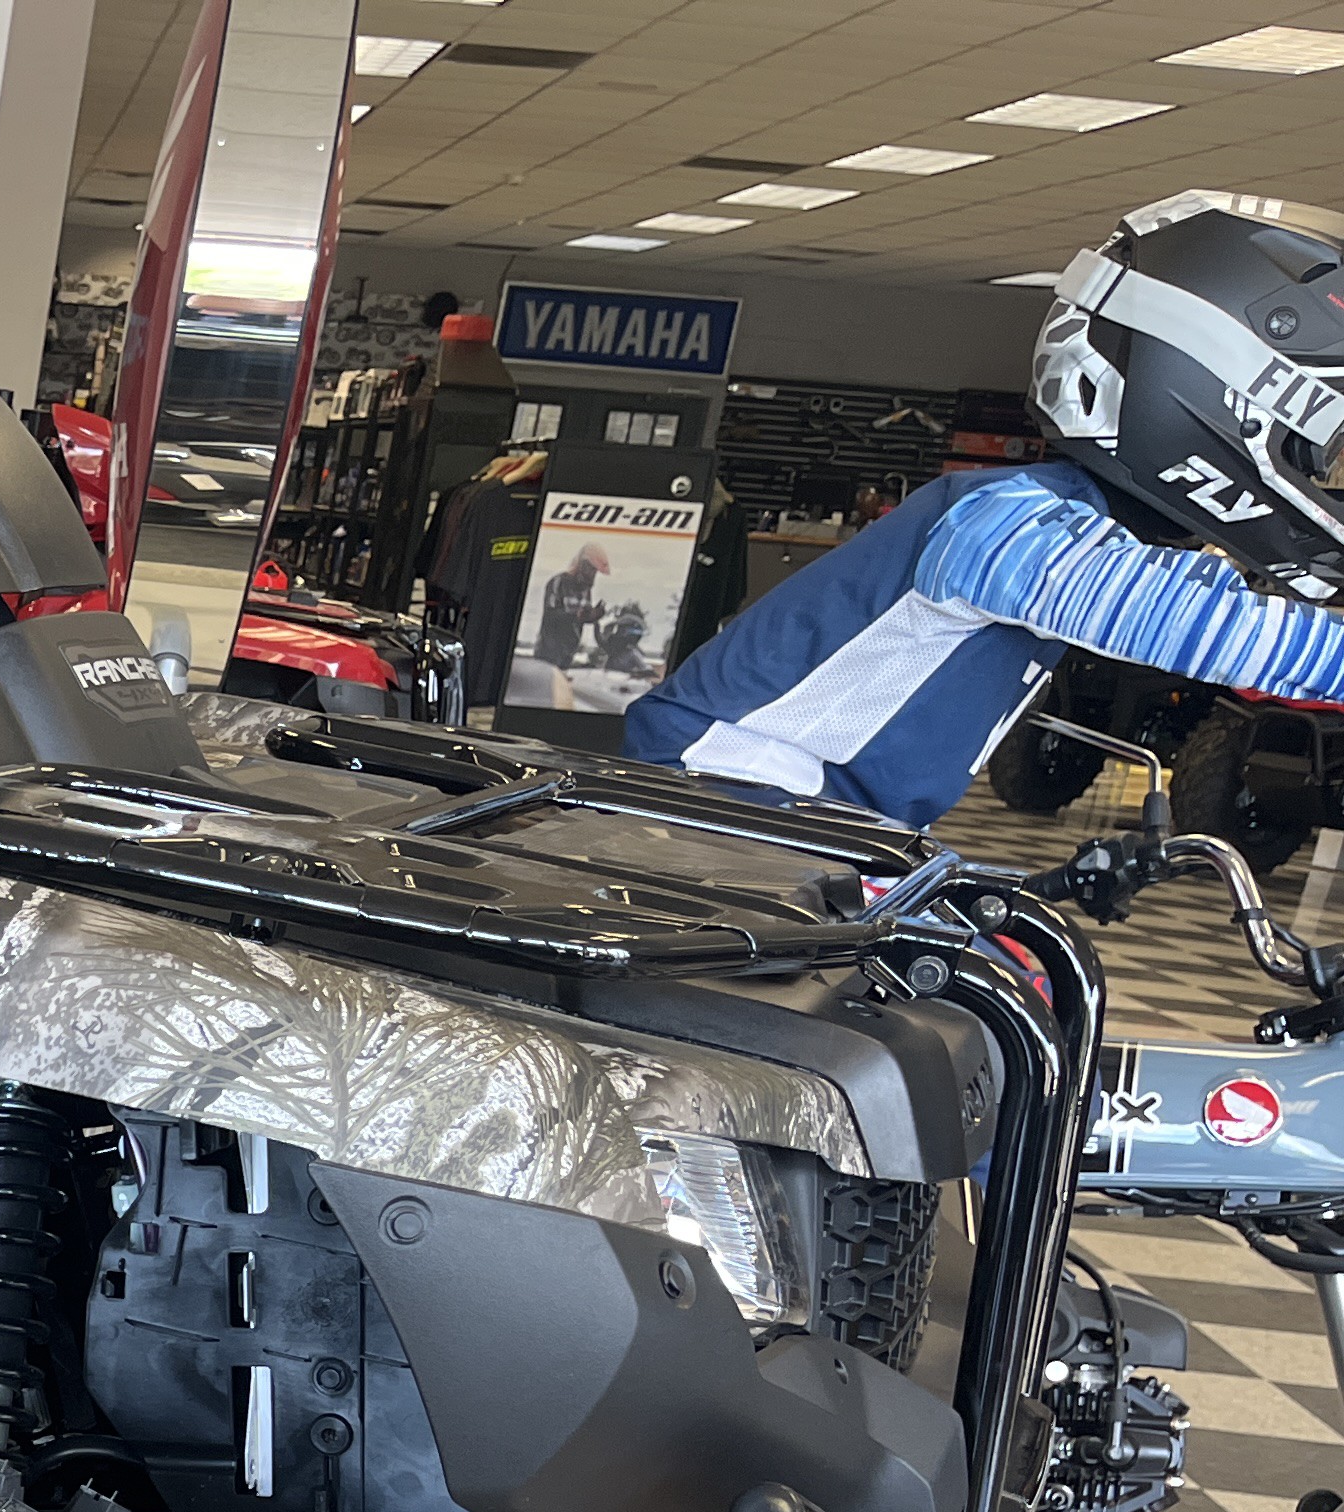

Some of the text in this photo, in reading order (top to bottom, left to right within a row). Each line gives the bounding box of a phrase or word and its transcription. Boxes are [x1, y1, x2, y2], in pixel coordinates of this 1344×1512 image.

[525, 300, 710, 362] YAMAHA
[1246, 356, 1336, 429] FLY
[551, 501, 694, 529] can-am
[1157, 455, 1274, 522] FLY
[73, 657, 161, 689] RANCHE
